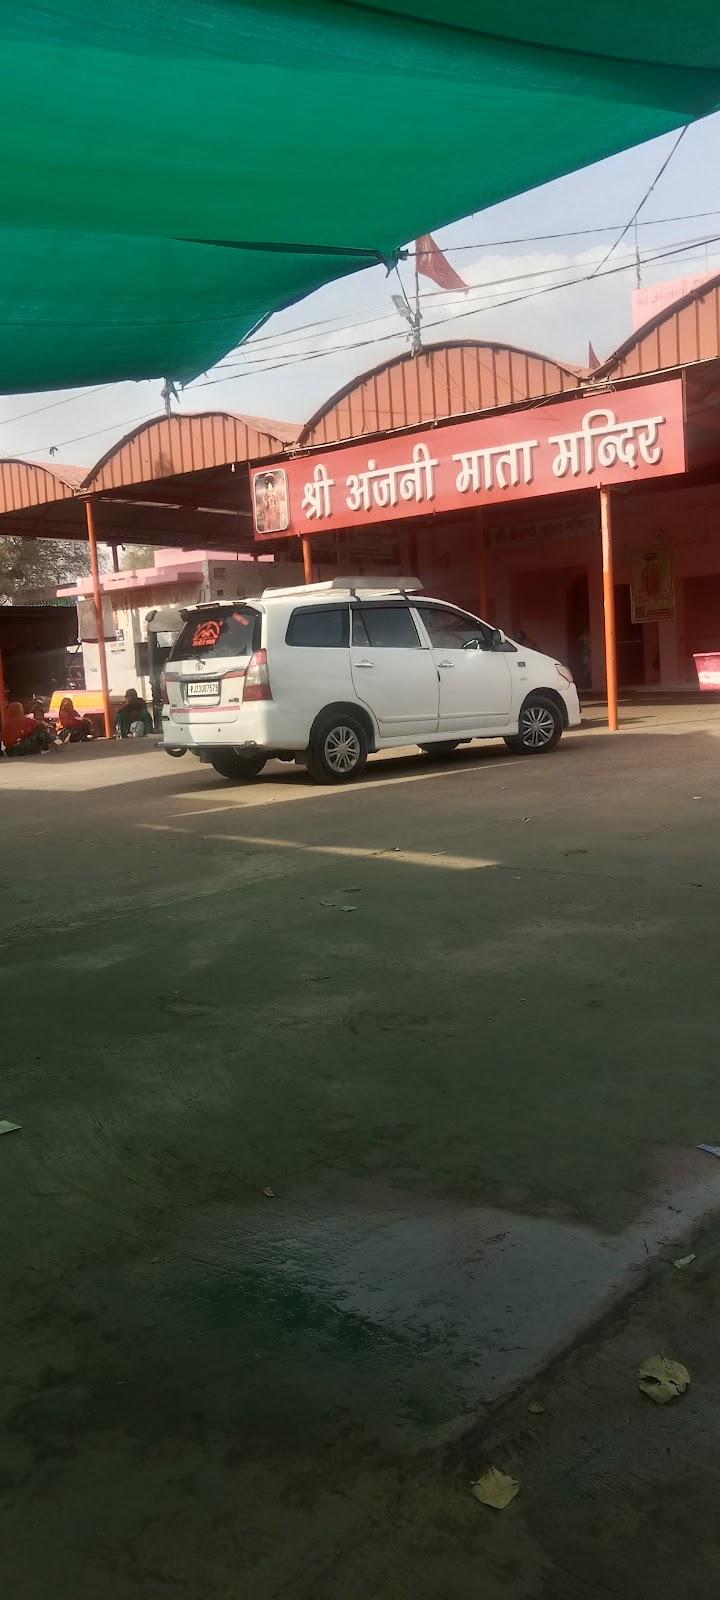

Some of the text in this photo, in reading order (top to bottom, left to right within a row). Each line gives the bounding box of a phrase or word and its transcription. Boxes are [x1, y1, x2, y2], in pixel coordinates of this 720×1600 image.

[301, 408, 665, 519] श्री अंजनी माता मन्दिर
